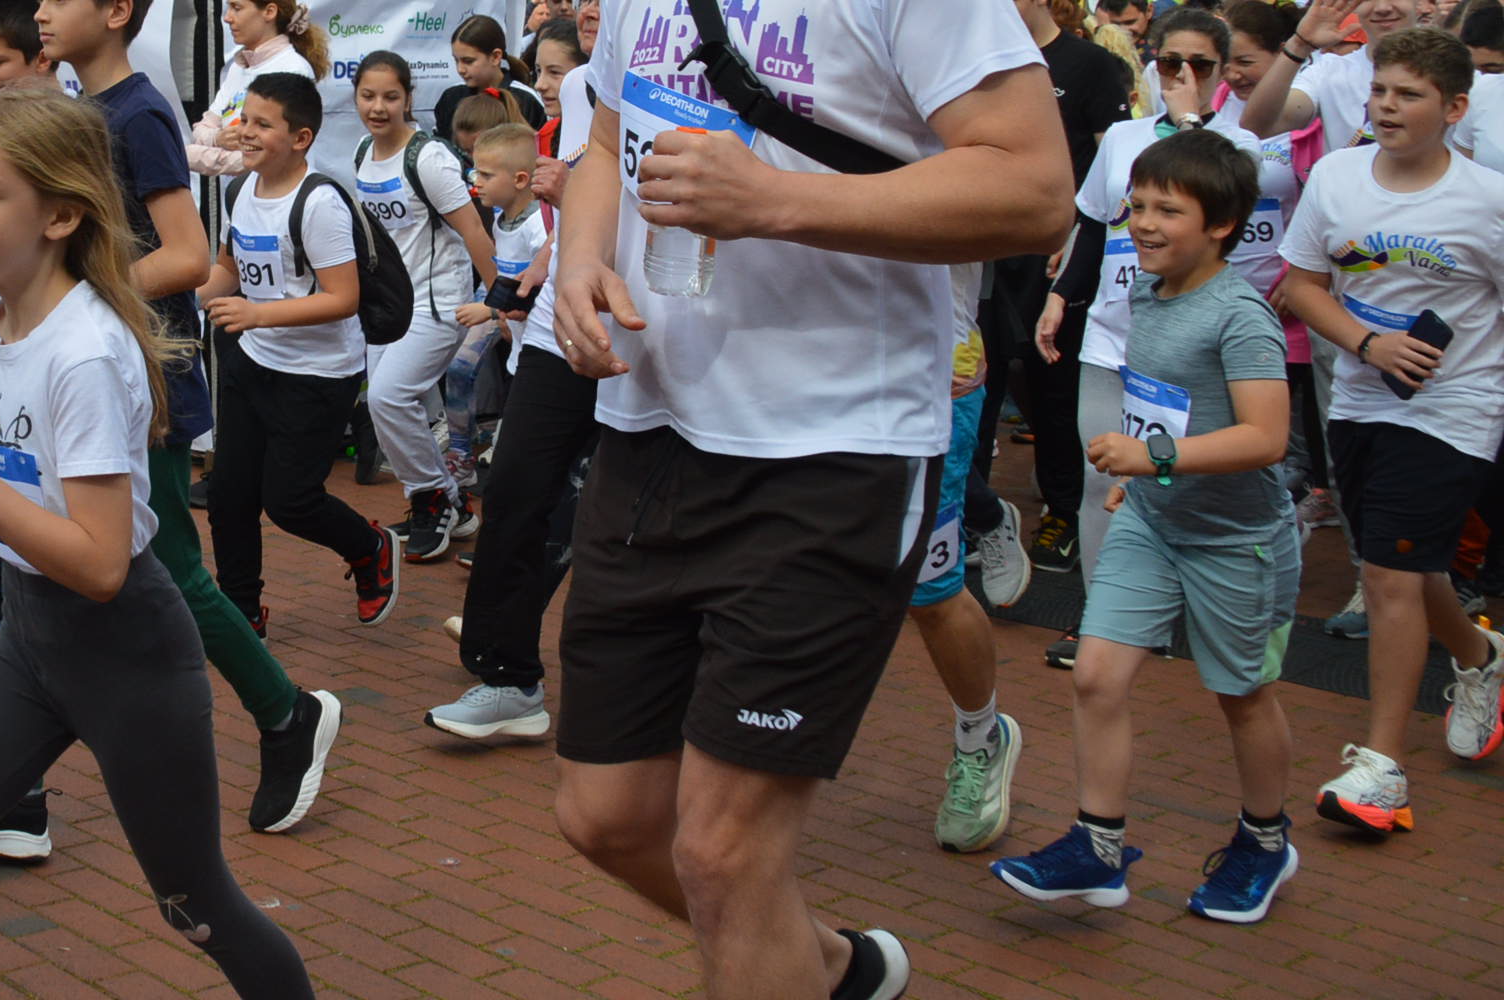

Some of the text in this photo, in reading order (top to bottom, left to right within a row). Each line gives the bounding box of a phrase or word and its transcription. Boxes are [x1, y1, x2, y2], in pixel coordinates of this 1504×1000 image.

[633, 46, 660, 65] 2022
[762, 56, 804, 80] CITY
[660, 91, 710, 119] DECATHLON
[1364, 231, 1457, 270] Marathon
[1115, 264, 1142, 289] 41
[737, 708, 789, 731] JAKO
